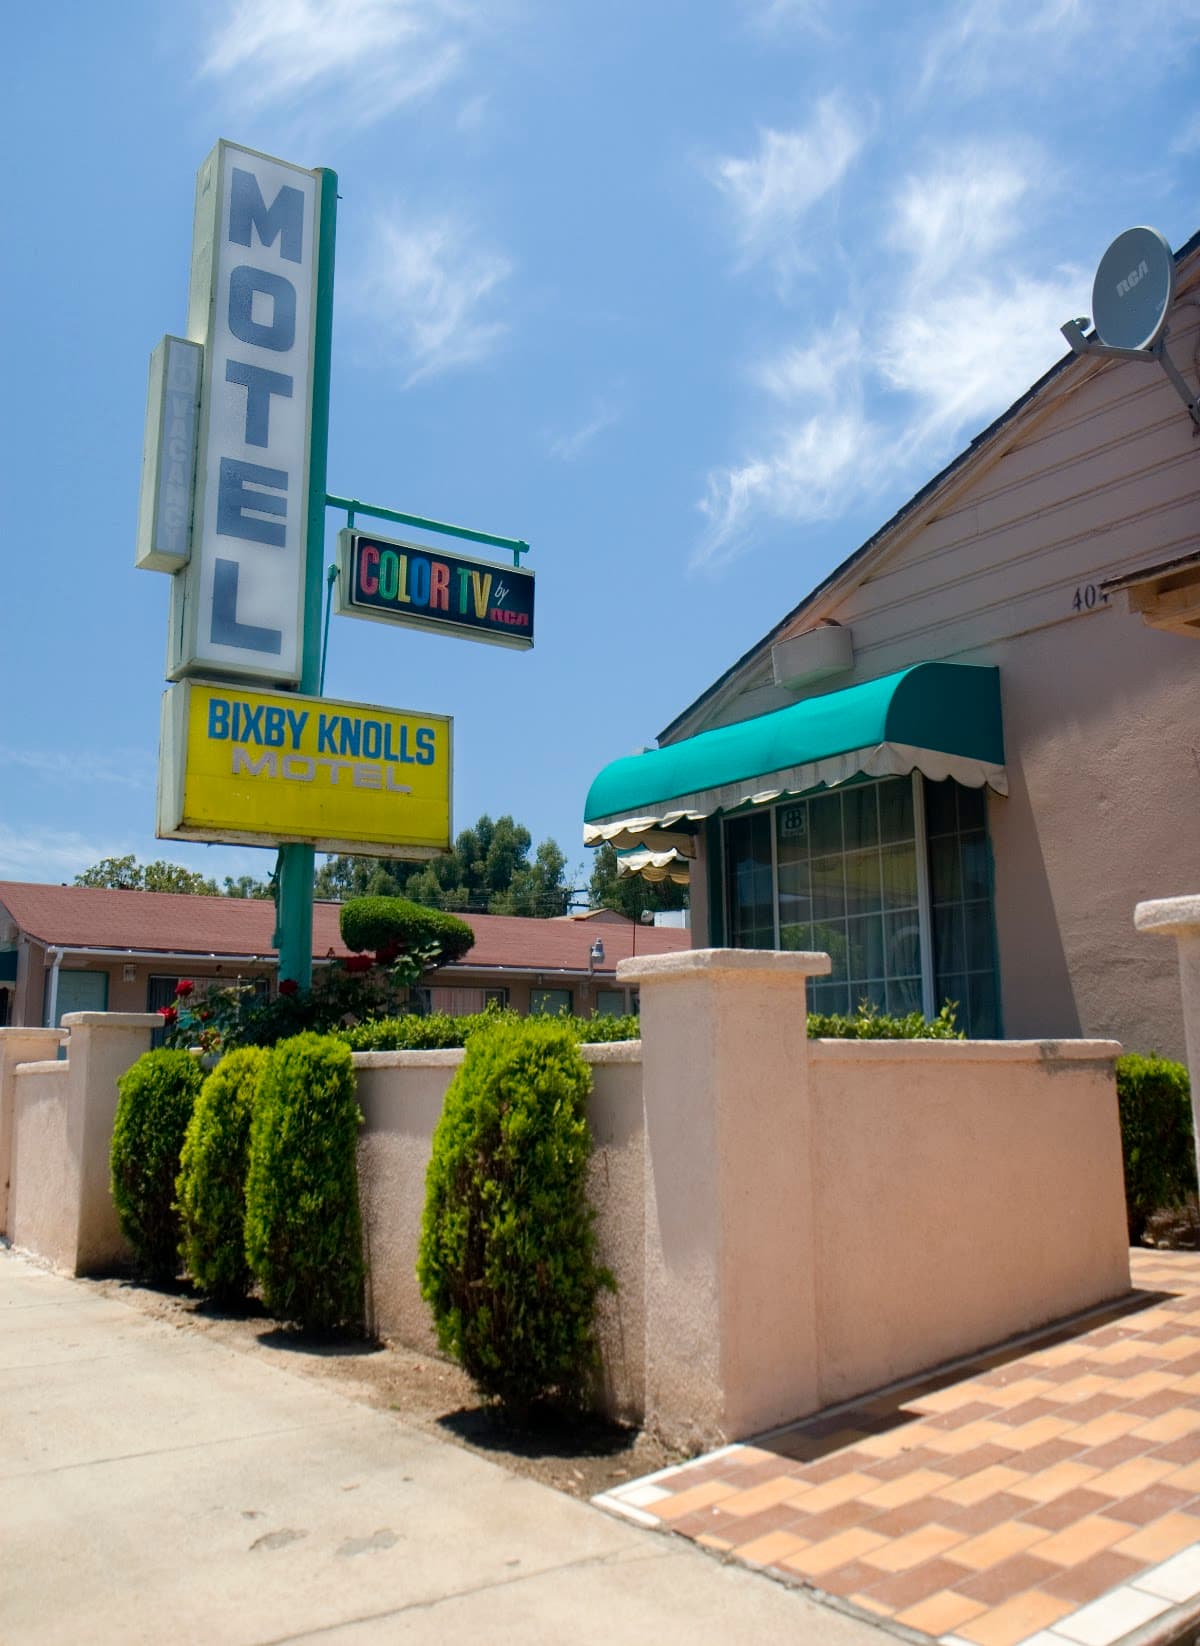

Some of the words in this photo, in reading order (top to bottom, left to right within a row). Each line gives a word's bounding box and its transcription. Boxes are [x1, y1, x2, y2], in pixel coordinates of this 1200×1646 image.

[1116, 260, 1148, 297] RCA
[210, 167, 305, 656] MOTEL
[360, 545, 450, 611] COLOR
[457, 567, 492, 619] TV
[494, 580, 509, 606] by
[490, 608, 529, 626] RCA
[208, 698, 309, 750] BIXBY
[318, 714, 435, 766] KNOLLS
[232, 747, 412, 794] MOTEL
